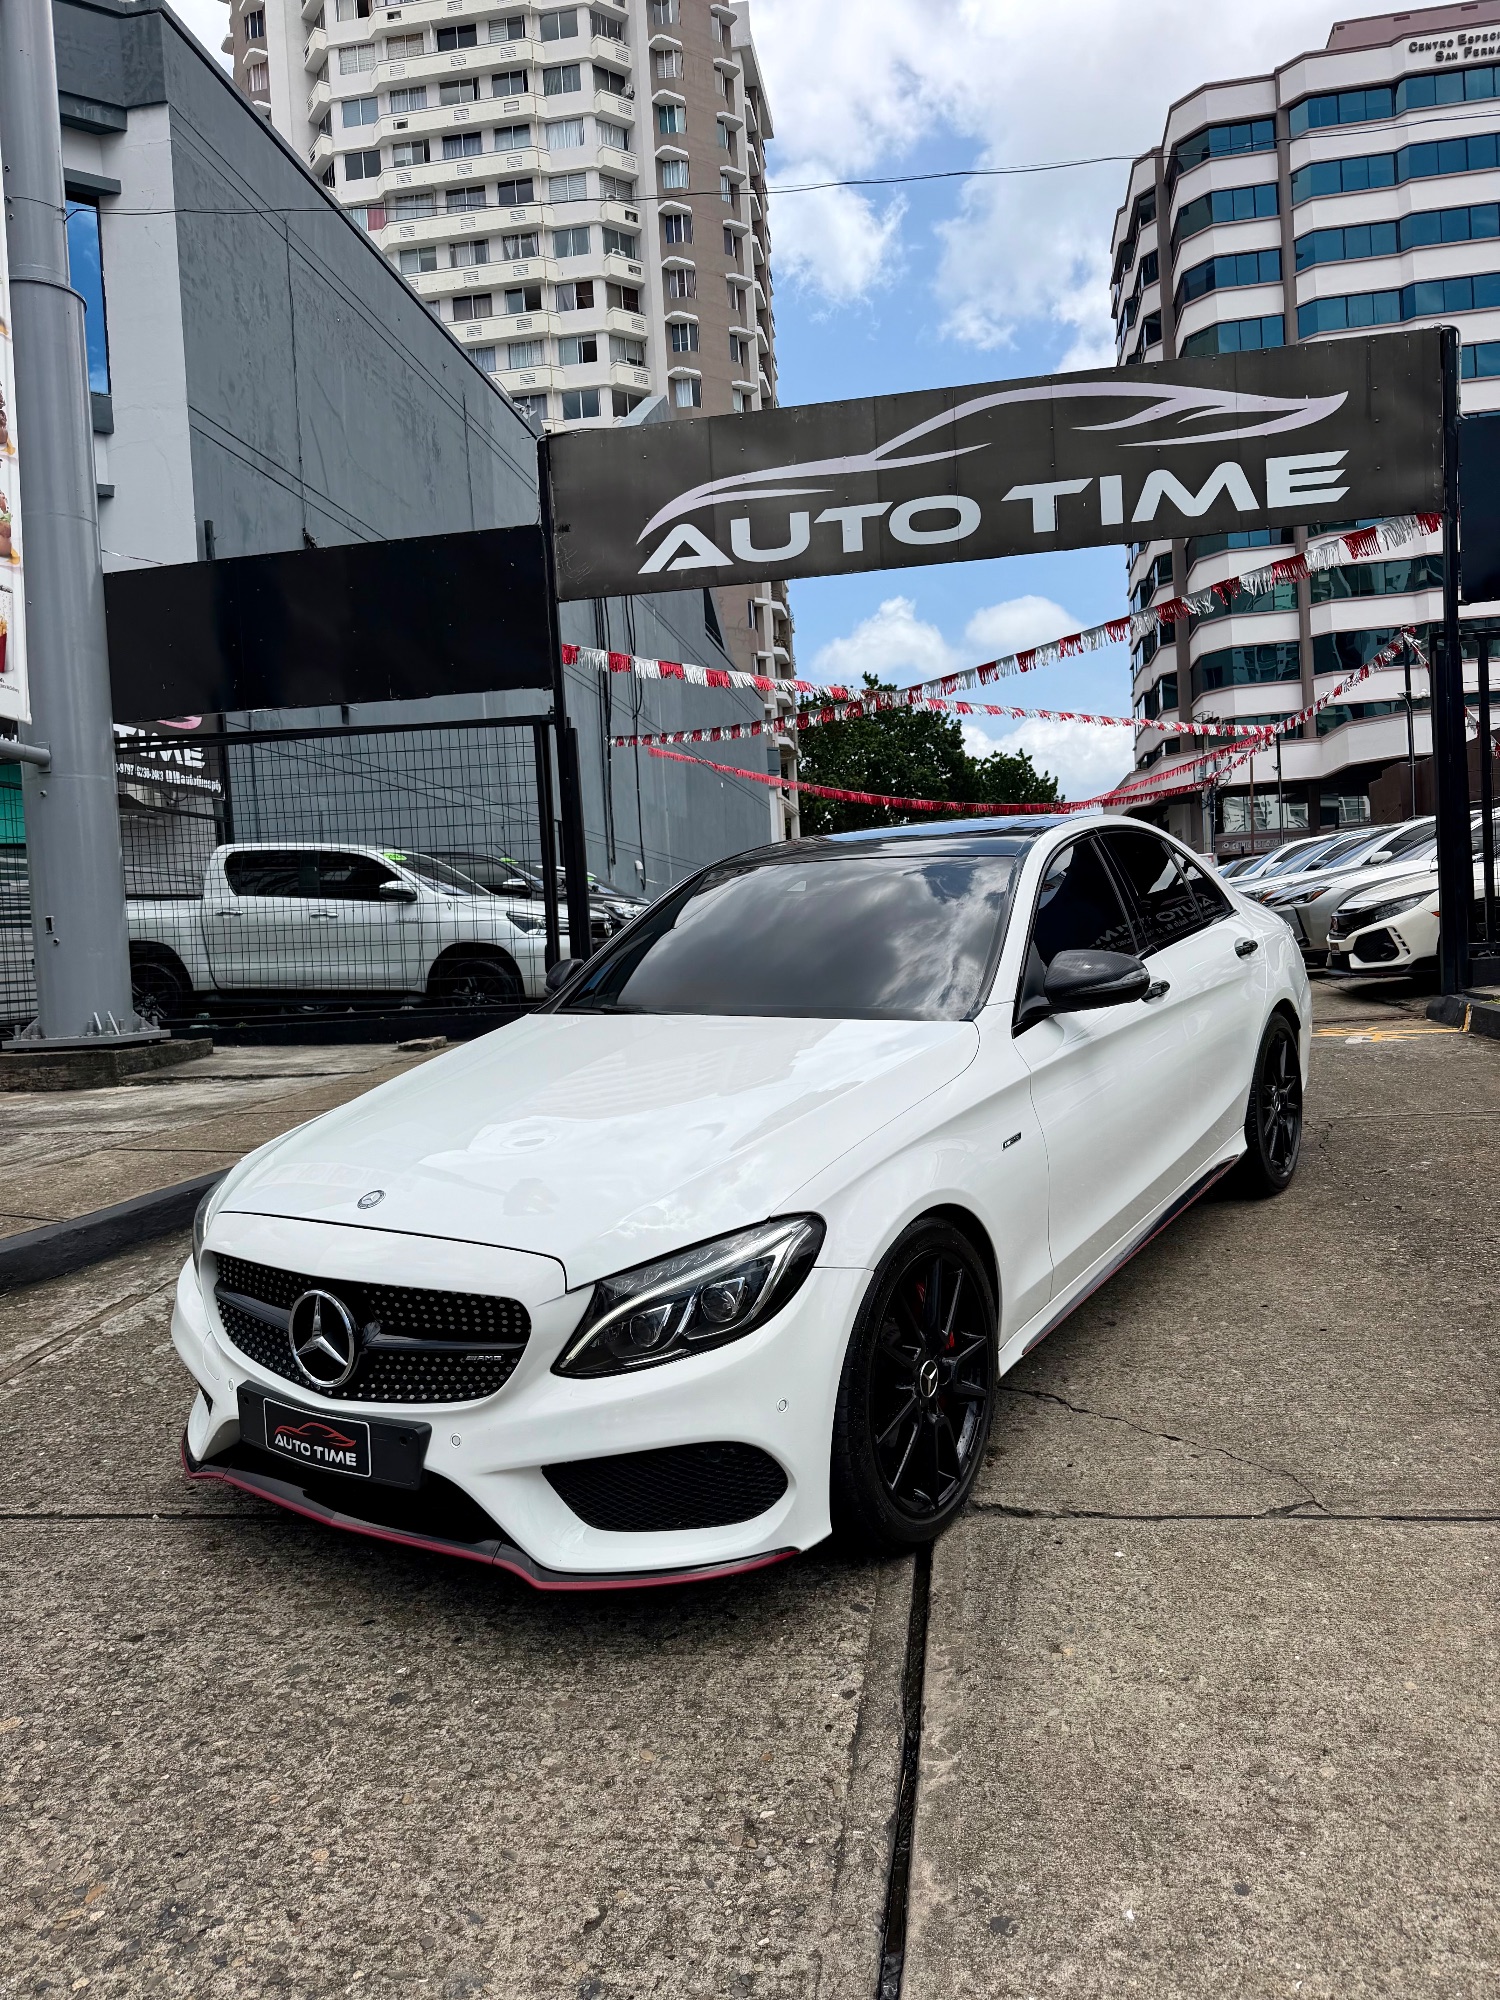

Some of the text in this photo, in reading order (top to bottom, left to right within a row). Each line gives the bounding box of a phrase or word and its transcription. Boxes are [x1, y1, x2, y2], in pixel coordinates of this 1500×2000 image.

[1408, 38, 1454, 53] CENTRO
[1435, 50, 1458, 62] SAN
[638, 450, 1350, 574] AUTO TIME
[113, 723, 206, 769] TIME
[274, 1433, 357, 1467] AUTO TIME
